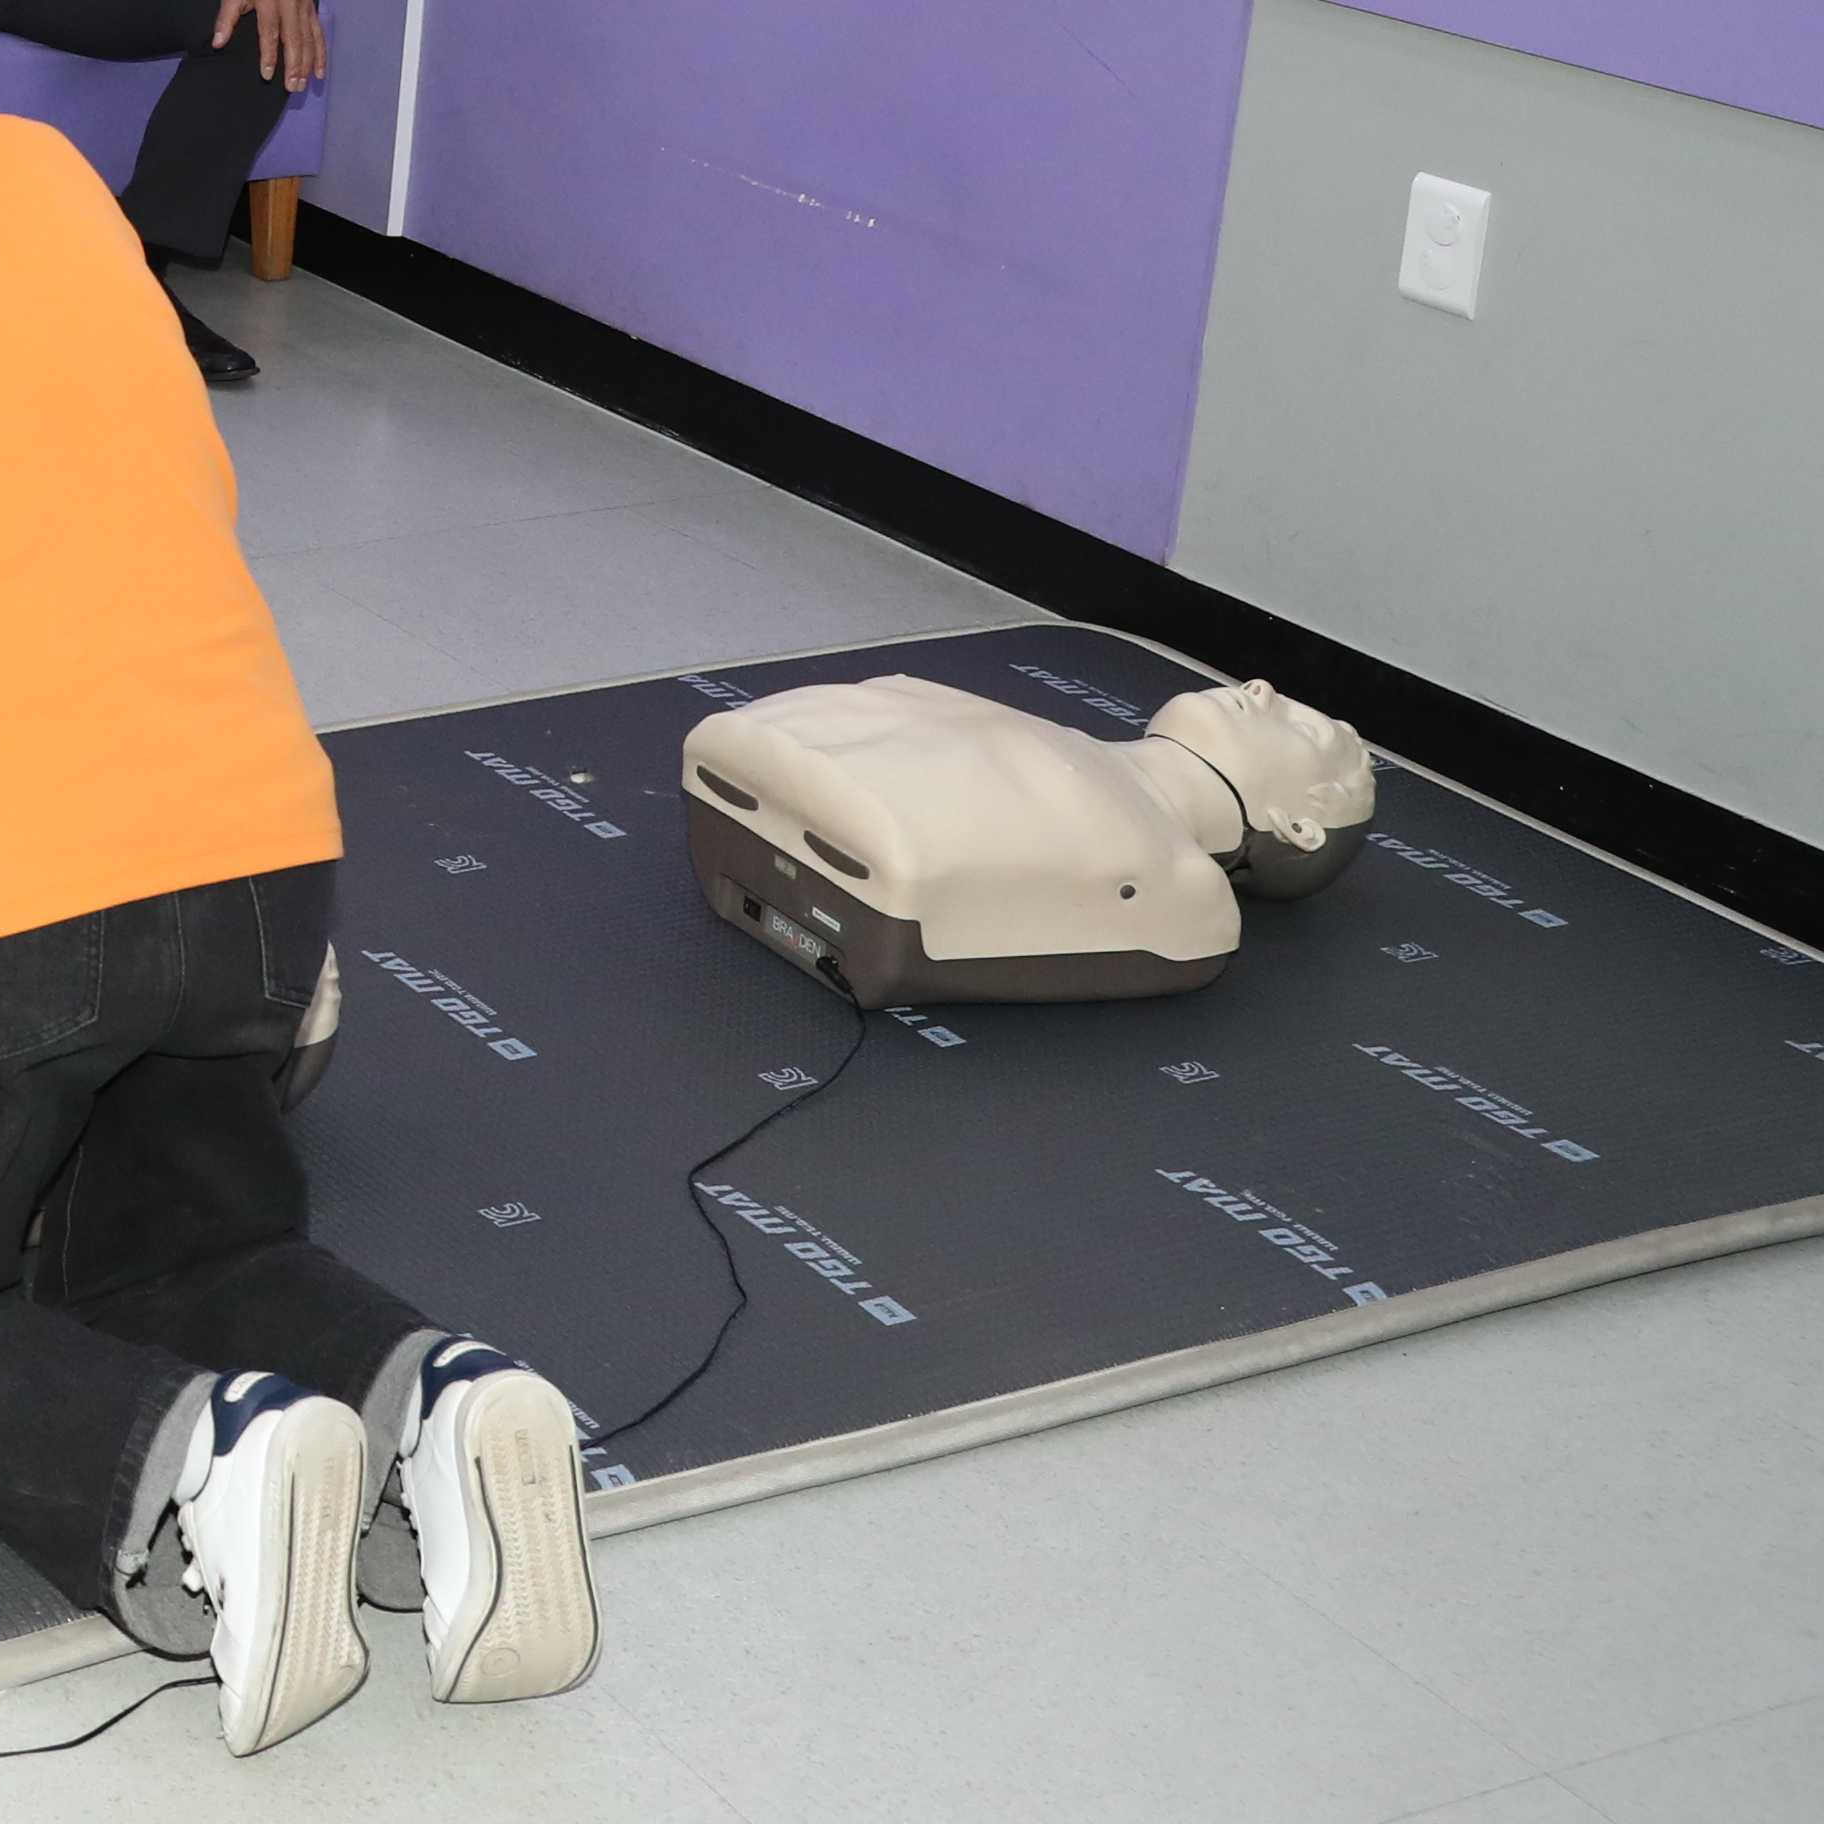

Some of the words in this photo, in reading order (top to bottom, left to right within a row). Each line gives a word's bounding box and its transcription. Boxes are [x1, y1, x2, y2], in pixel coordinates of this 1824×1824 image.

[361, 950, 446, 993] MAT
[431, 998, 503, 1038] TGO
[694, 1182, 797, 1235] MAT
[783, 1242, 873, 1296] TGO
